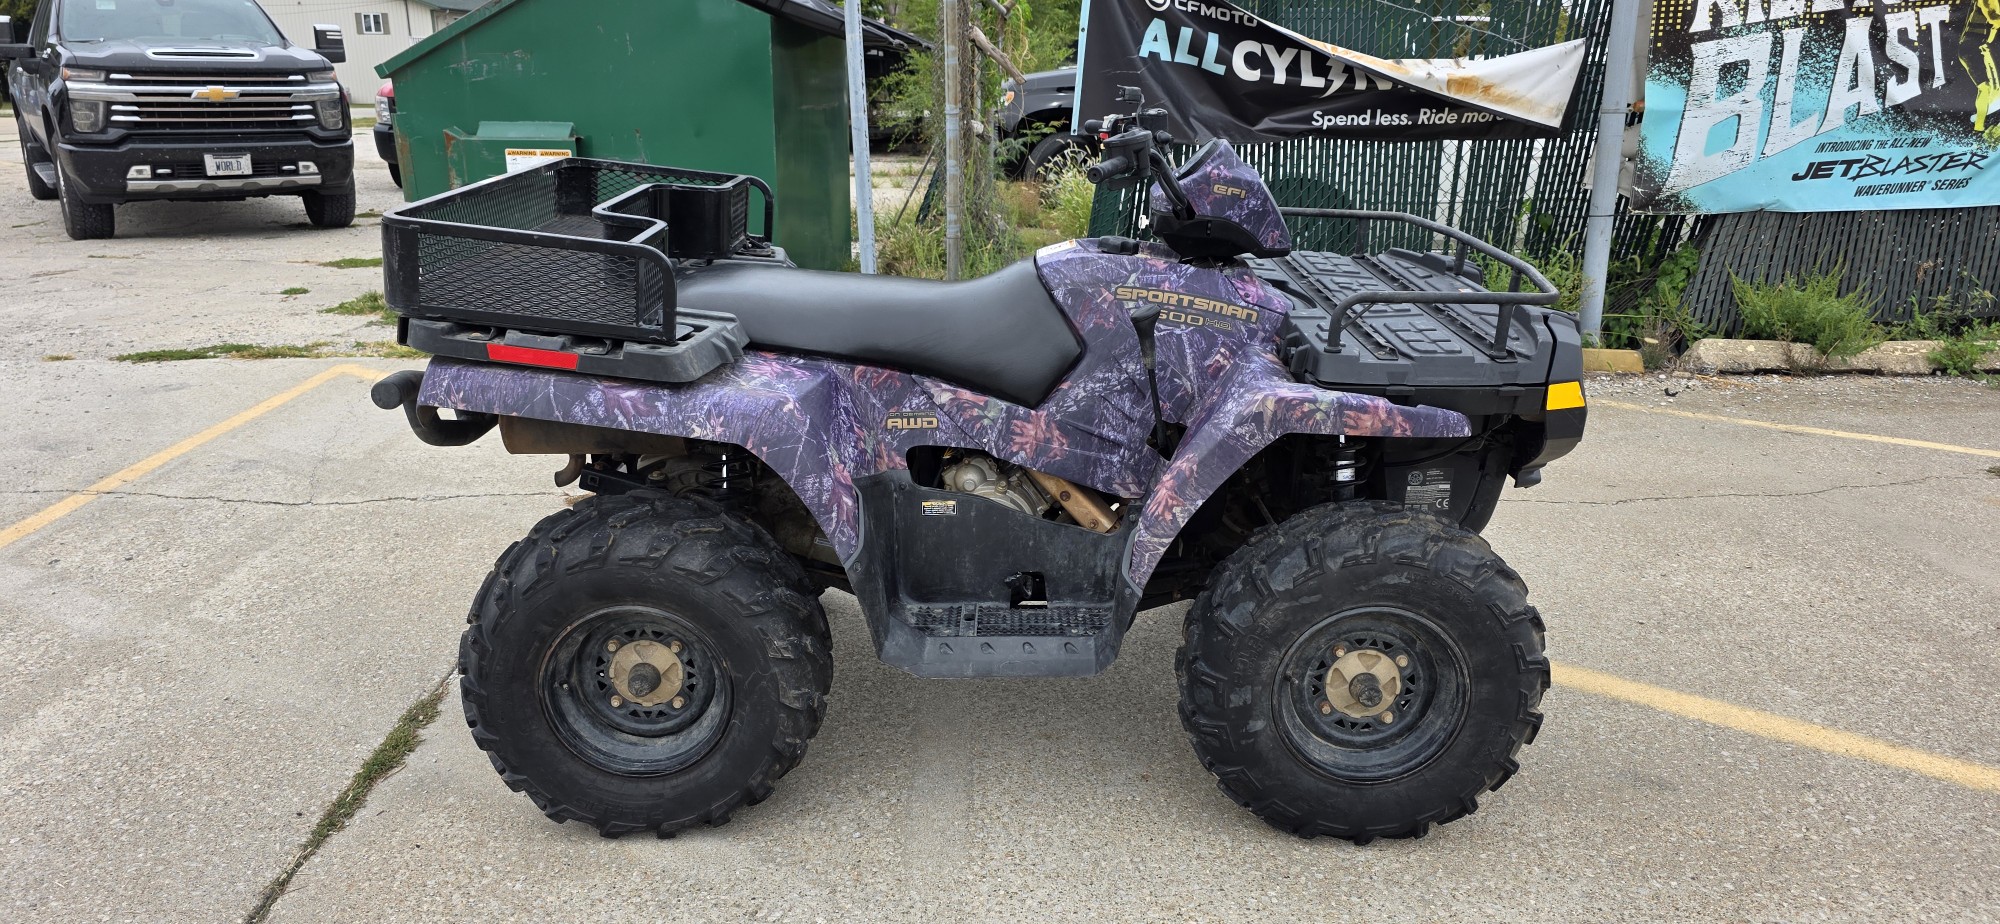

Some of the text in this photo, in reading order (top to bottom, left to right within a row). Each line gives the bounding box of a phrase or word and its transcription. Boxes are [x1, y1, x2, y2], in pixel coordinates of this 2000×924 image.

[1174, 0, 1258, 28] CFMOTO
[1661, 4, 1951, 195] BLAST
[1311, 109, 1371, 130] Spend
[1375, 108, 1413, 126] less.
[1417, 107, 1458, 125] Ride
[1814, 136, 1933, 154] INTRODUCING THE ALL-NEW
[1213, 184, 1246, 199] EFI
[1931, 177, 1973, 191] SERIES
[1116, 287, 1258, 323] SPORTSMAN
[887, 417, 938, 430] AWD
